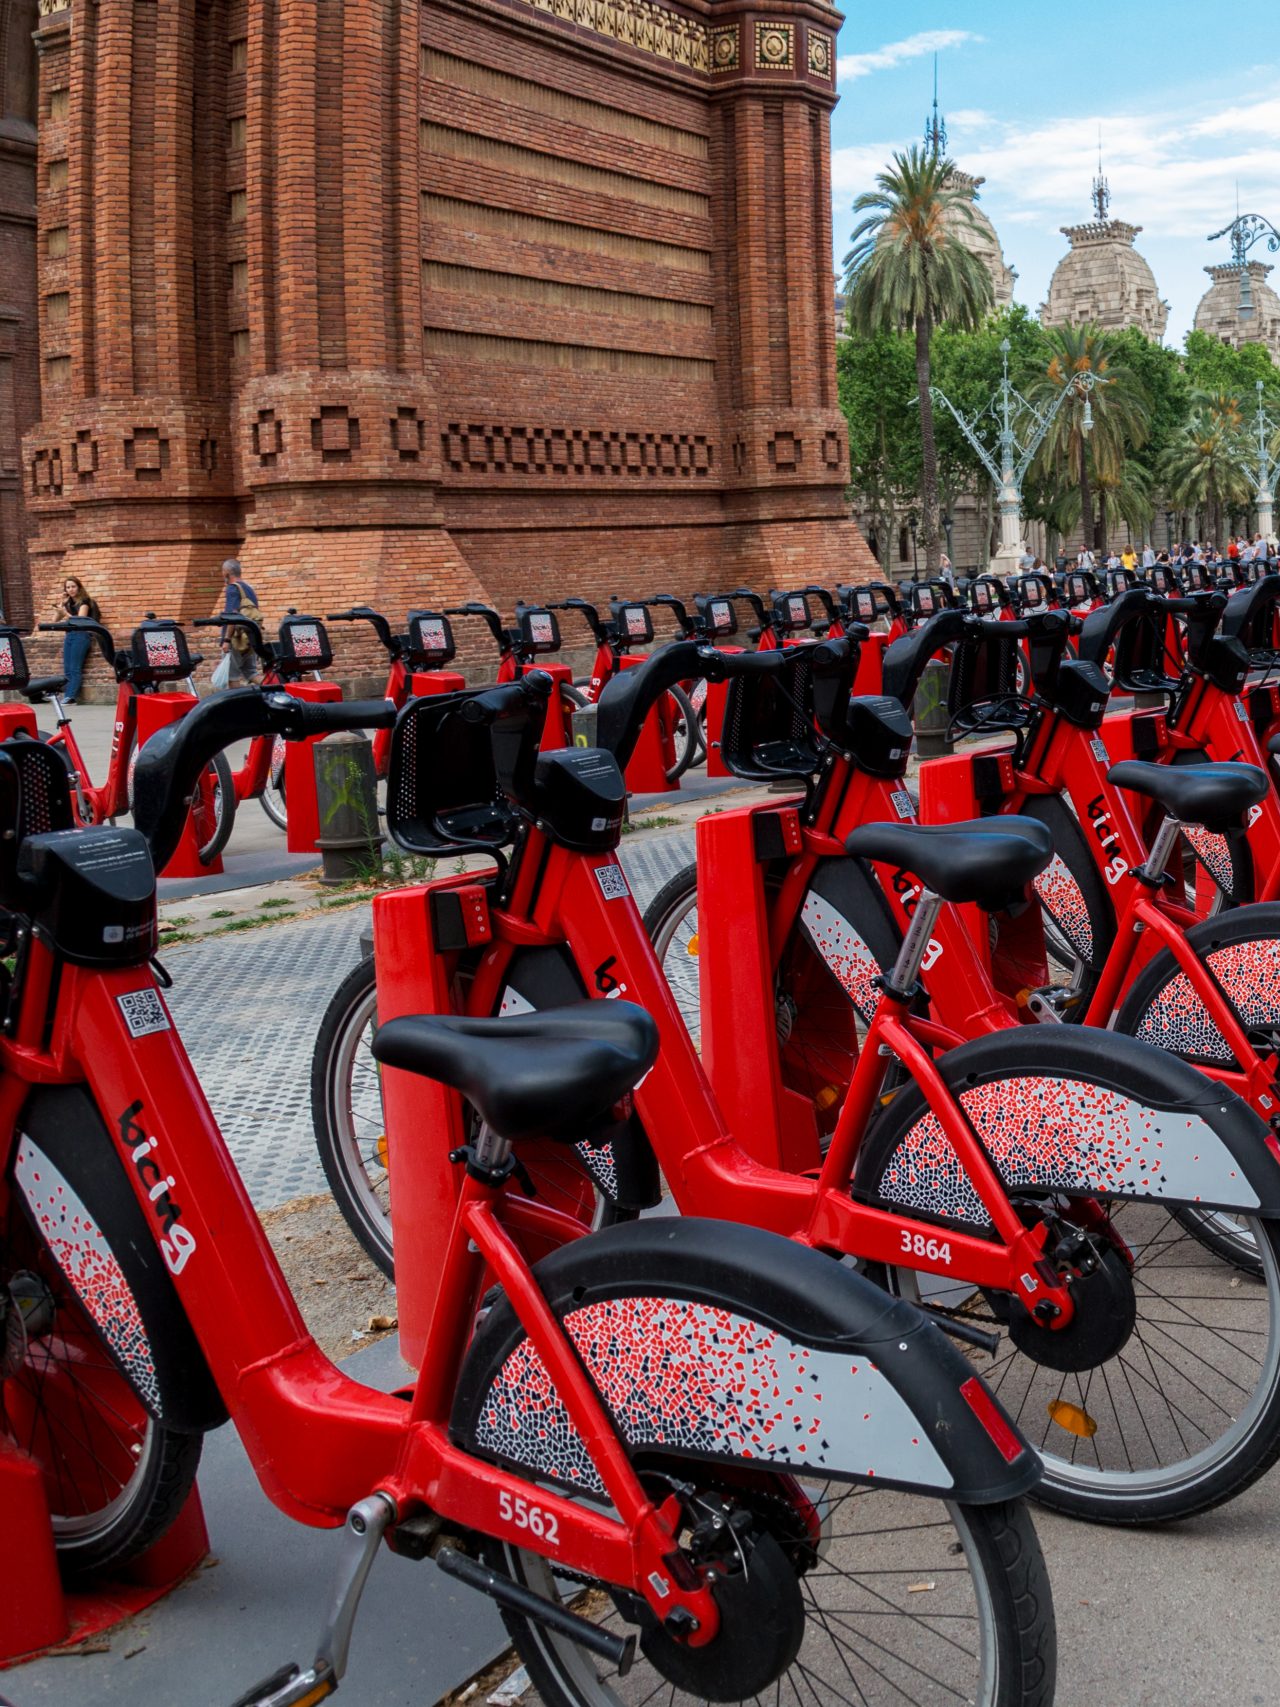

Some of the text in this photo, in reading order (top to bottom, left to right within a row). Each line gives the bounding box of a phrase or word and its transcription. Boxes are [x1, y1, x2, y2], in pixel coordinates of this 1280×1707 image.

[1088, 794, 1128, 884] bicing
[118, 1100, 196, 1275] bicing
[900, 1230, 952, 1265] 3864
[499, 1491, 560, 1546] 5562
